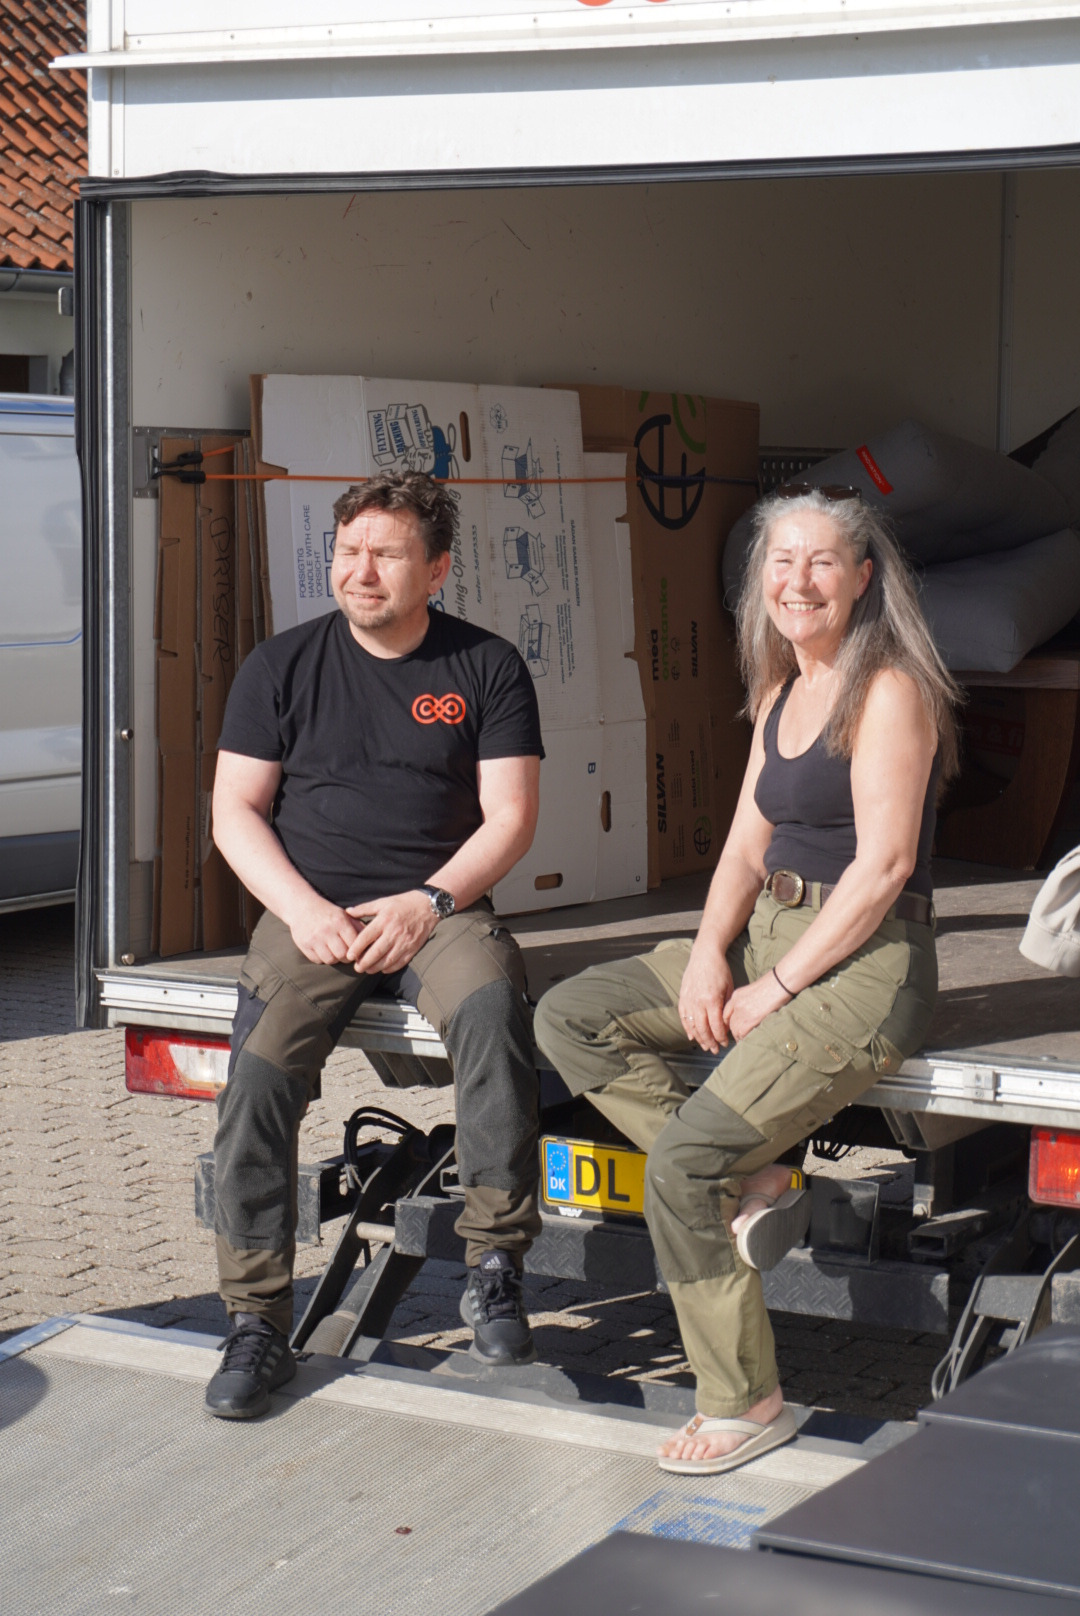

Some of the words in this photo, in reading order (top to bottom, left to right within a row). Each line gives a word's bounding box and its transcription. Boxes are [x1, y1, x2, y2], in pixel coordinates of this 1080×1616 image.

[373, 413, 387, 452] FLYTNING
[303, 505, 311, 531] CARE
[305, 534, 313, 558] WITH
[297, 547, 307, 598] FORSIGTIG
[306, 560, 315, 598] HANDLE
[314, 550, 323, 598] VORSICHT
[660, 577, 669, 681] omtanke
[690, 620, 698, 678] SILVAN
[650, 629, 659, 681] med
[588, 762, 596, 774] B
[656, 752, 667, 834] SILVAN
[550, 1176, 566, 1190] DK
[575, 1154, 630, 1203] DL
